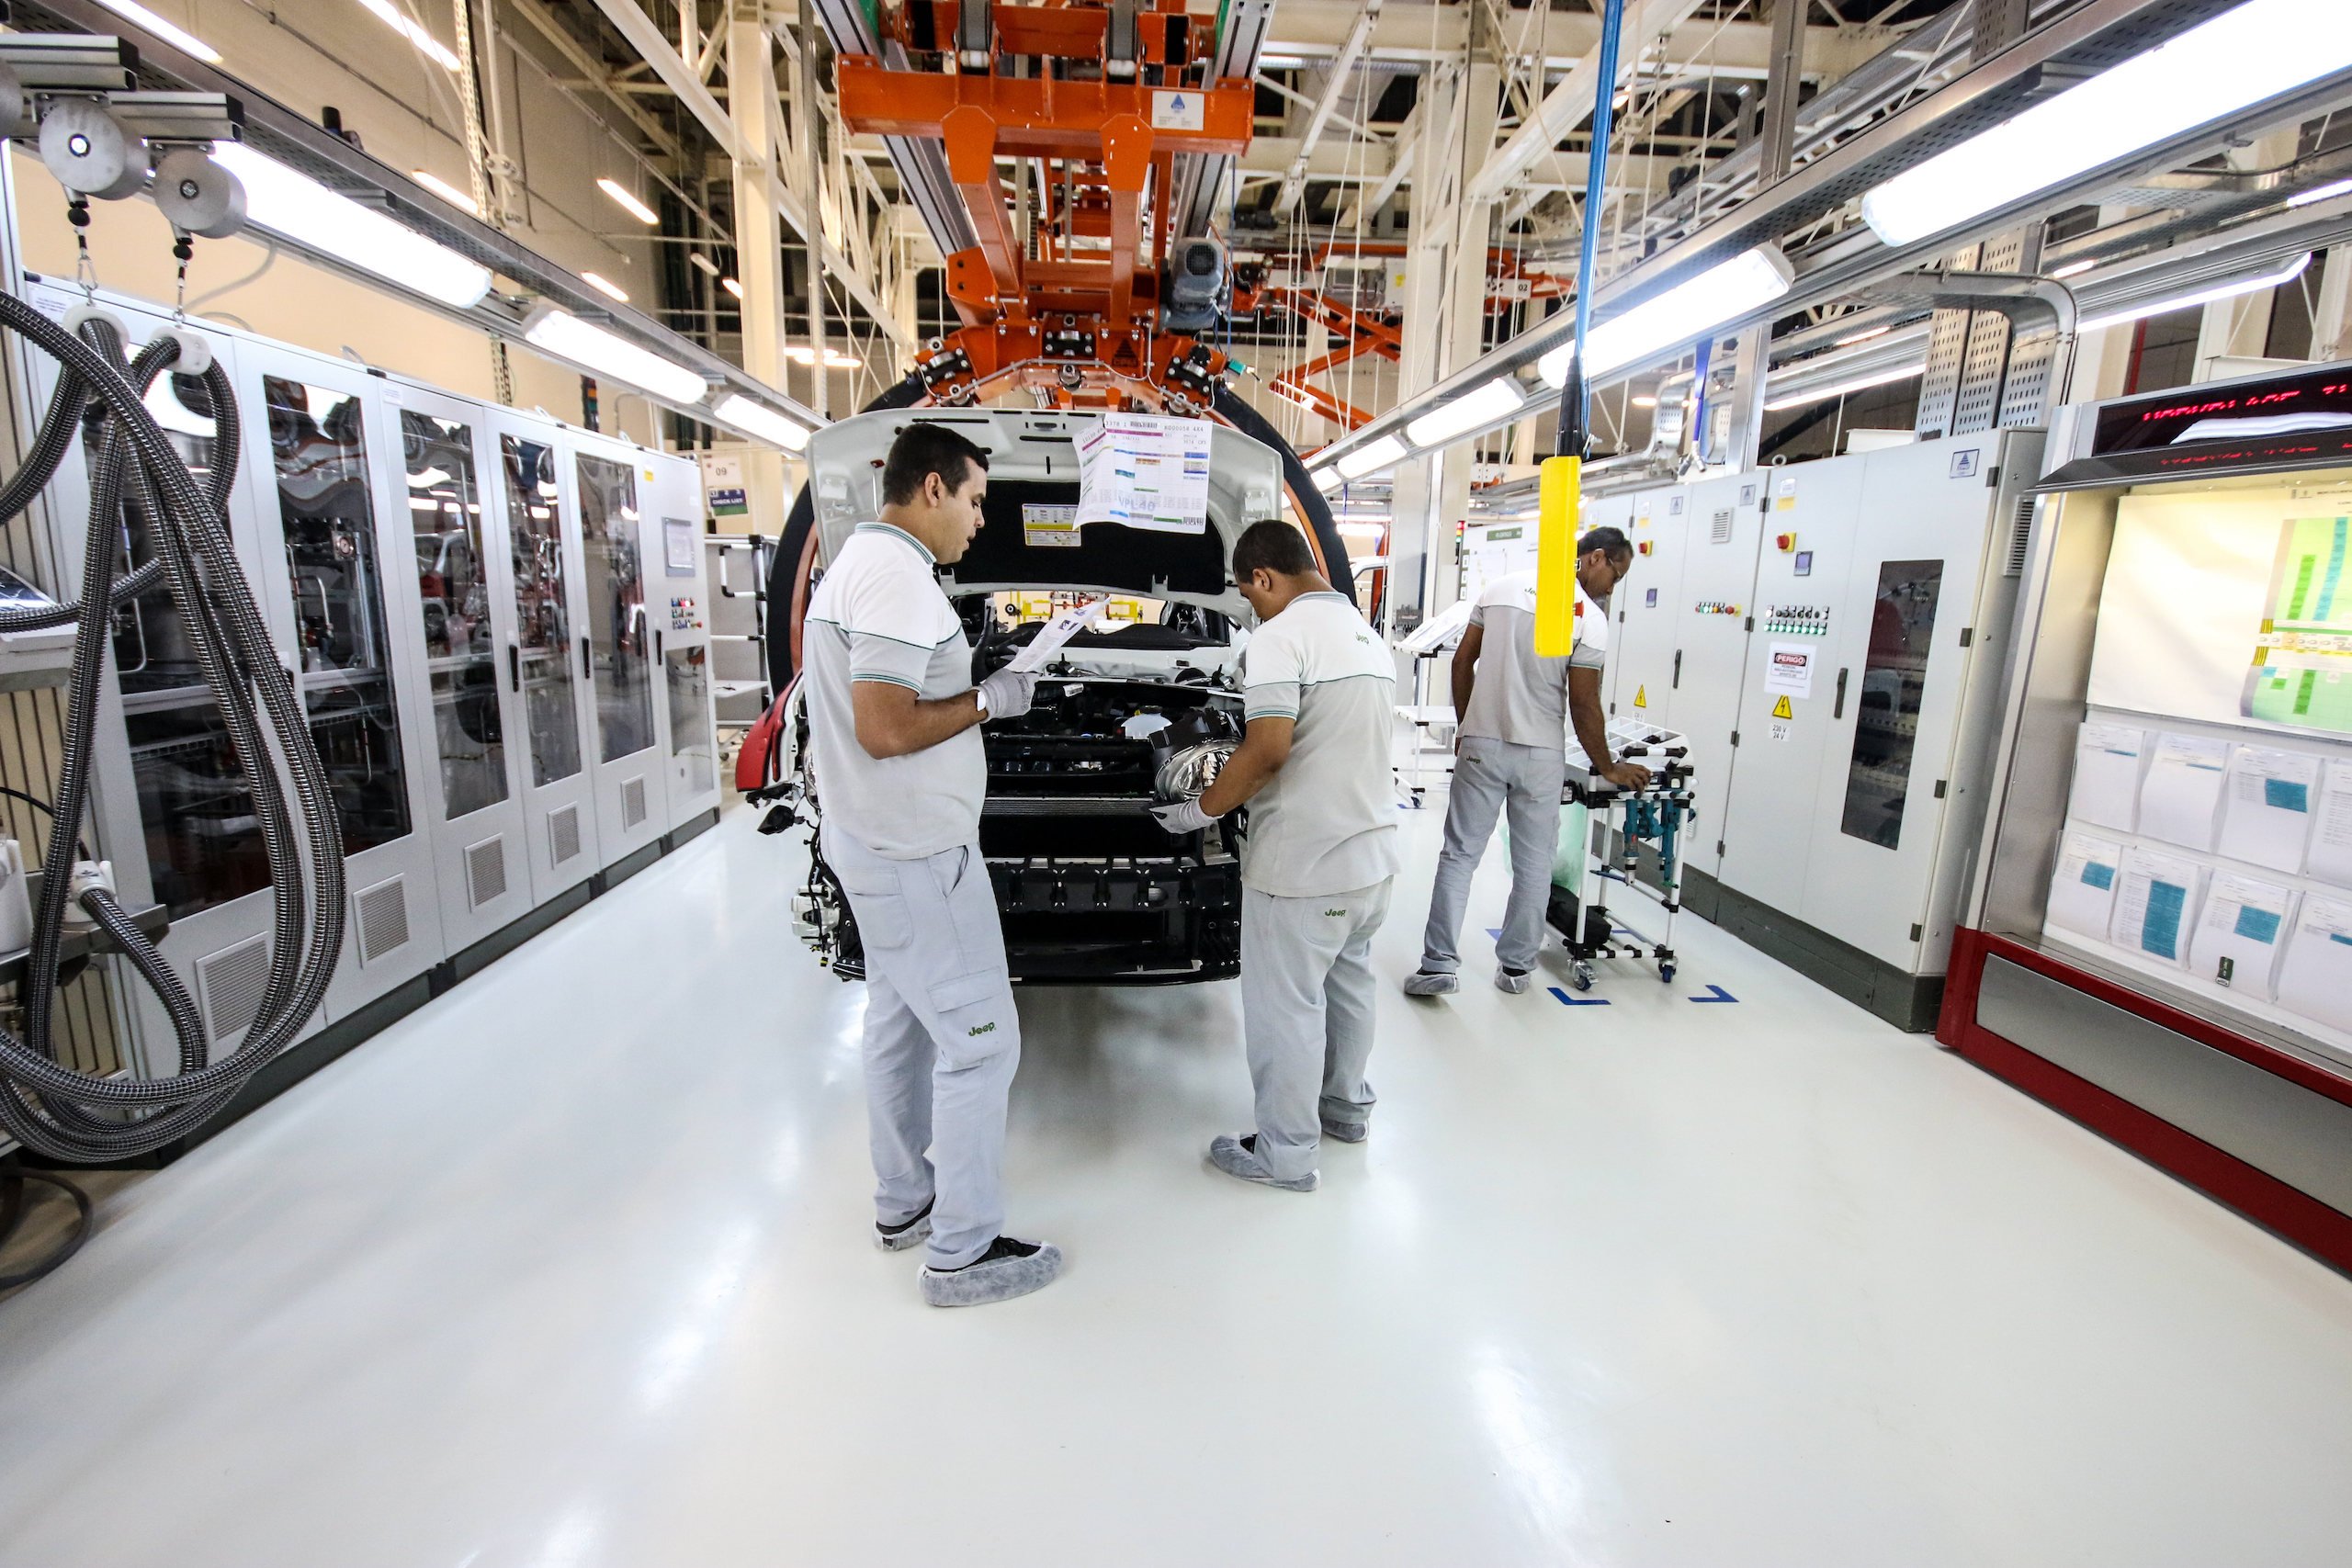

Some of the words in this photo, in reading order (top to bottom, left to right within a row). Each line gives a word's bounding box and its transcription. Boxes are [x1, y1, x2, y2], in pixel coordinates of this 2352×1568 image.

[1518, 283, 1528, 291] 02
[716, 467, 727, 476] 09
[1777, 654, 1805, 663] PERIGO
[1324, 908, 1346, 917] Jeep
[967, 1021, 995, 1037] Jeep
